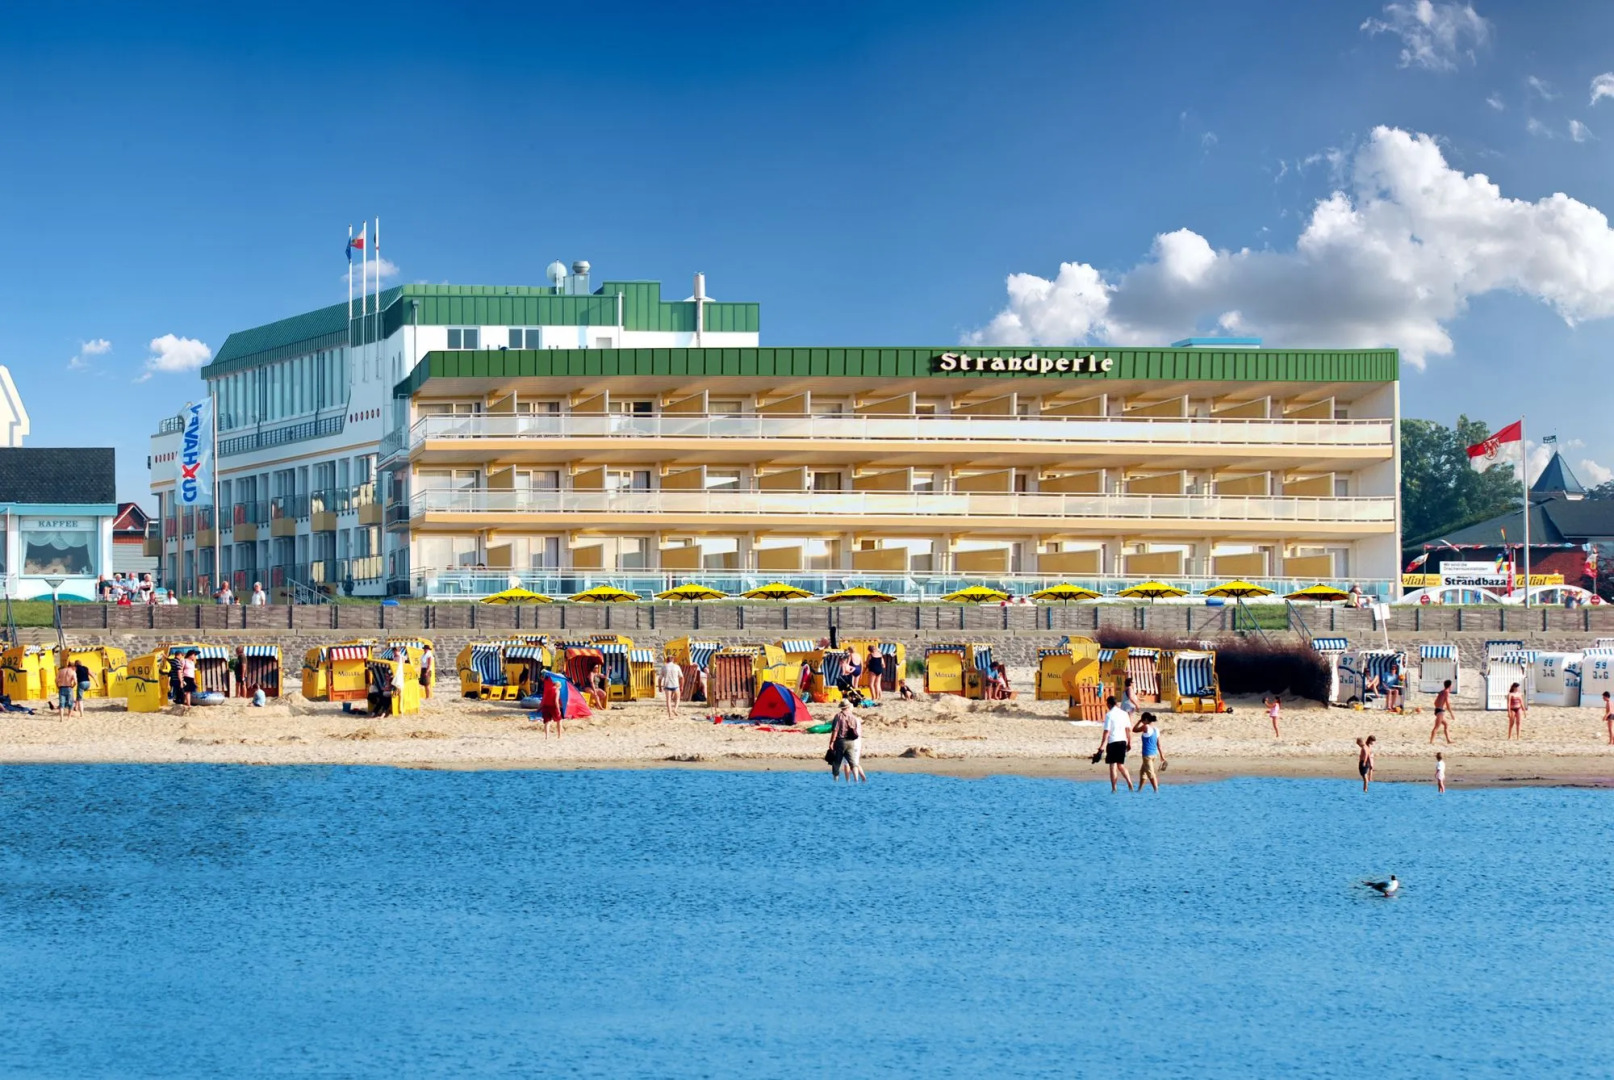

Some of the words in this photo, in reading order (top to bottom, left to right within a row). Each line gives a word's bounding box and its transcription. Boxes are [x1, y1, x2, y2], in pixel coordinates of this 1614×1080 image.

[940, 353, 1114, 374] Strandperle
[38, 520, 78, 528] KAFFEE
[1401, 575, 1426, 586] elial
[1444, 577, 1508, 586] Strandbaza
[1516, 575, 1547, 586] dlial
